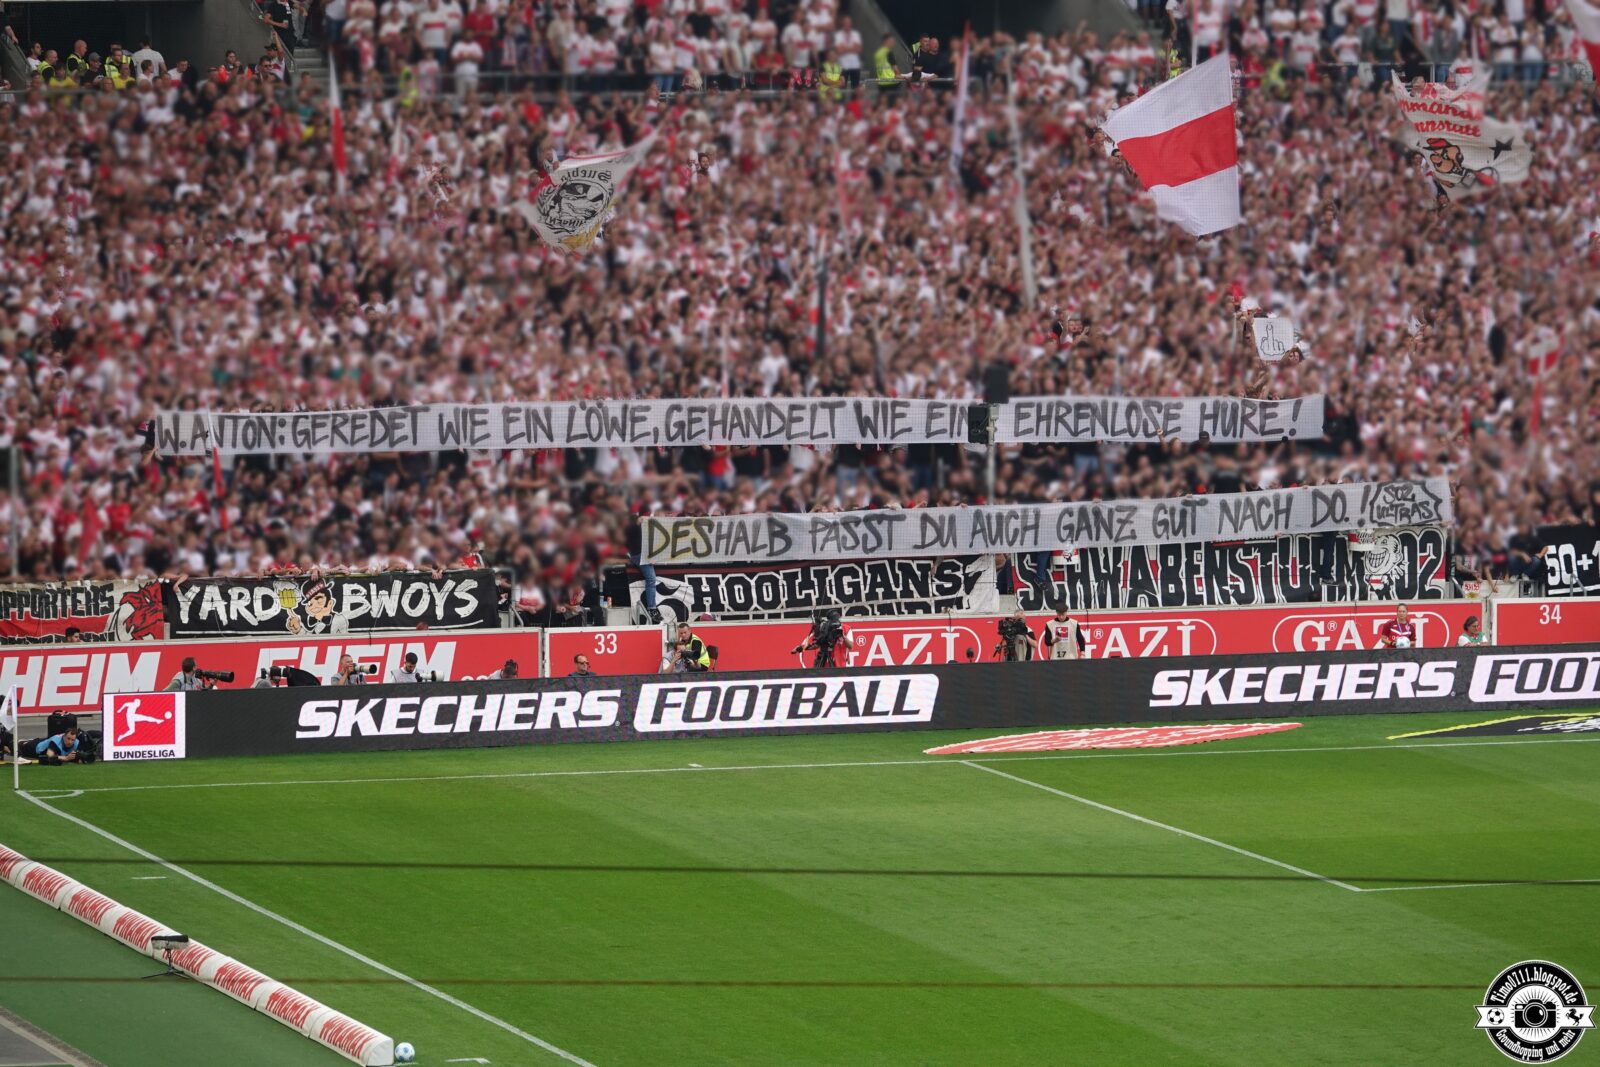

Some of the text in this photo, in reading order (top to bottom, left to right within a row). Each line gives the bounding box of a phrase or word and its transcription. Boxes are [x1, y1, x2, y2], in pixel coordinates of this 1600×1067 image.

[438, 407, 491, 446] WIE
[502, 405, 553, 443] EIN
[853, 401, 913, 440] WIE
[1013, 401, 1185, 438] EHRENLOSE
[647, 512, 792, 559] DESHALB
[808, 513, 906, 554] PASST
[913, 508, 958, 550] DU
[969, 506, 1041, 548] AUCH
[1056, 504, 1138, 544] GANZ
[1151, 499, 1210, 541] GUT
[1217, 494, 1294, 534] NACH
[1376, 501, 1433, 524] ULTRAS
[685, 560, 964, 614] HOOLIGANS
[1394, 526, 1445, 603] 02
[0, 583, 115, 620] PPORTERS
[176, 584, 281, 626] YARD
[342, 579, 479, 621] BWOYS
[1540, 604, 1562, 625] 34
[595, 633, 617, 655] 33
[1056, 650, 1067, 658] 17
[1149, 660, 1458, 707] SKECHERS
[296, 674, 920, 739] SKECHERS FOOTBALL
[113, 749, 176, 760] BUNDESLIGA
